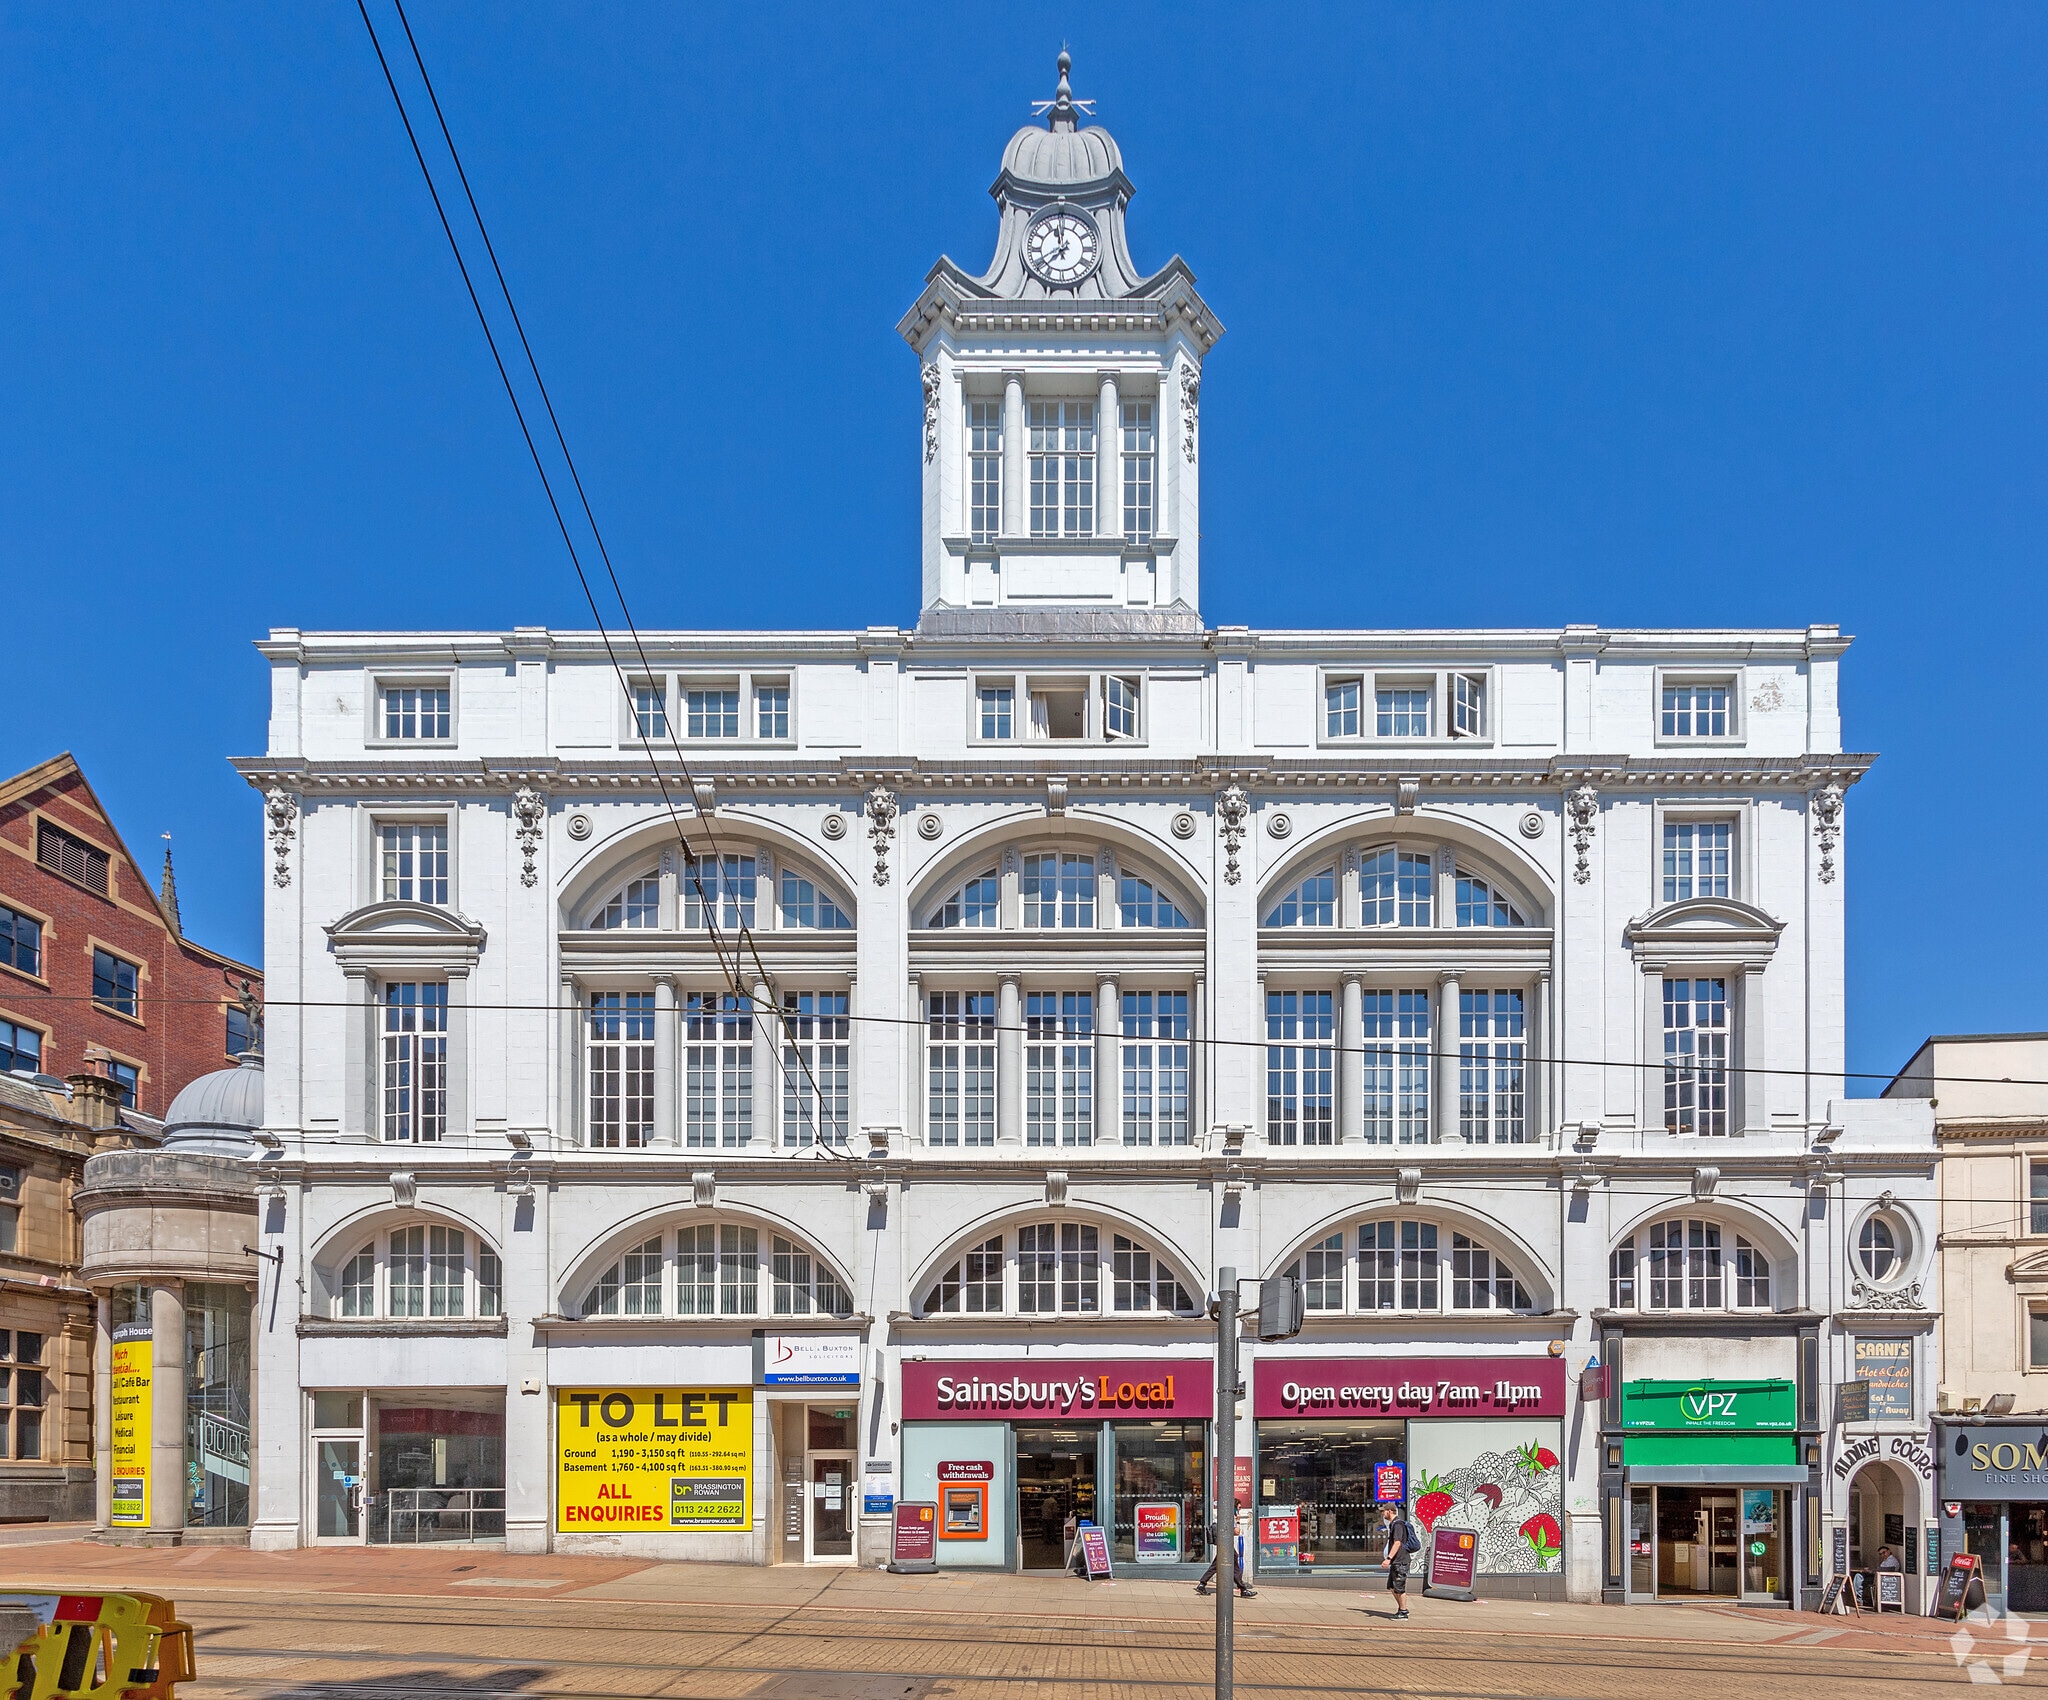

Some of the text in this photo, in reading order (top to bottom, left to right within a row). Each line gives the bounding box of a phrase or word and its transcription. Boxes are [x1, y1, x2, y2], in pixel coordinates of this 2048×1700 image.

[129, 1327, 152, 1336] House
[1855, 1343, 1909, 1359] SARNI'S
[1856, 1365, 1909, 1377] Hot & Cold
[136, 1377, 150, 1387] Bar
[1868, 1379, 1908, 1388] andwiches
[937, 1376, 1175, 1408] Sainsbury's Local
[1282, 1382, 1336, 1405] Open
[1340, 1384, 1393, 1405] every
[1397, 1381, 1433, 1405] day
[1437, 1380, 1481, 1400] 7am
[1494, 1380, 1542, 1404] 11pm
[1840, 1382, 1868, 1395] SARNI'S
[1688, 1392, 1738, 1416] VPZ
[1870, 1394, 1895, 1402] Eat In
[115, 1411, 134, 1421] Leisure
[570, 1393, 738, 1428] TO LET
[1885, 1406, 1909, 1415] Away
[115, 1427, 134, 1438] Medical
[596, 1432, 611, 1443] (as
[620, 1432, 648, 1442] whole
[656, 1434, 677, 1444] may
[678, 1431, 712, 1443] divide)
[114, 1444, 136, 1455] Financial
[564, 1449, 597, 1458] Ground
[612, 1449, 634, 1459] 1,190
[641, 1449, 665, 1459] 3,150
[666, 1451, 676, 1460] sq
[677, 1448, 685, 1458] ft
[1834, 1437, 1932, 1480] ALDINE COURT
[1972, 1442, 2048, 1471] SOM
[564, 1463, 607, 1472] Basement
[612, 1463, 634, 1473] 1,760
[641, 1463, 665, 1473] 4,100
[666, 1465, 676, 1474] sq
[677, 1462, 685, 1472] ft
[1985, 1473, 2016, 1483] FINE
[598, 1484, 632, 1499] ALL
[566, 1505, 664, 1522] ENQUIRIES
[1268, 1520, 1290, 1535] £3
